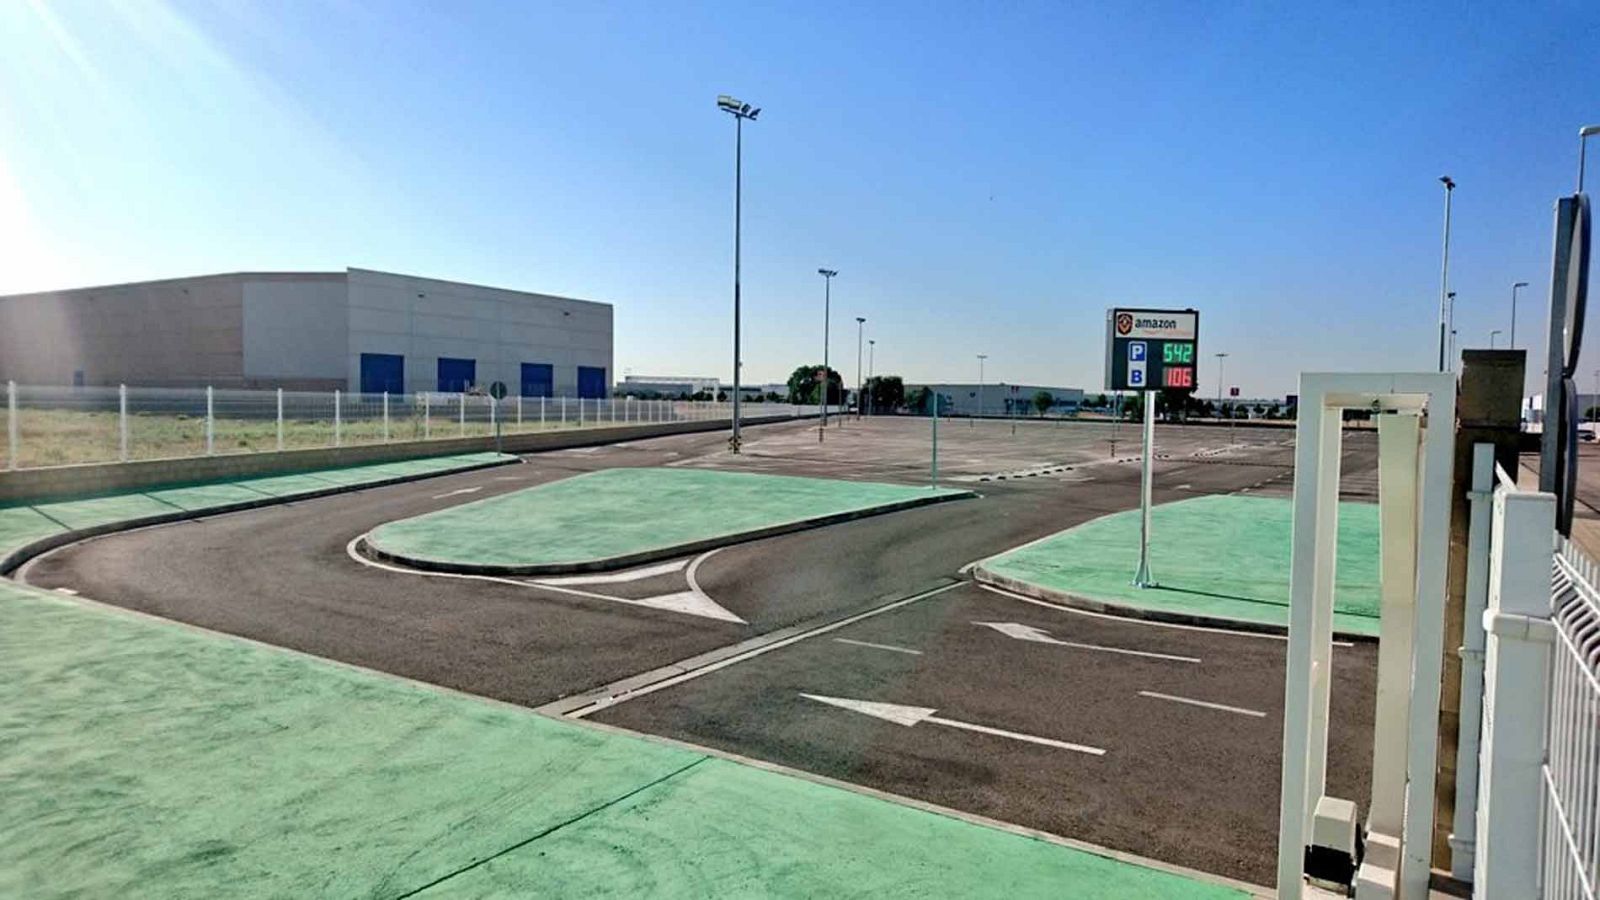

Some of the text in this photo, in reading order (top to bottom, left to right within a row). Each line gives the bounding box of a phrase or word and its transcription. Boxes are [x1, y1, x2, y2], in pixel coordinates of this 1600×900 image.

[1135, 318, 1176, 329] amazon
[1131, 345, 1144, 360] P
[1163, 344, 1193, 362] 542
[1130, 369, 1143, 384] B
[1167, 367, 1193, 387] 106
